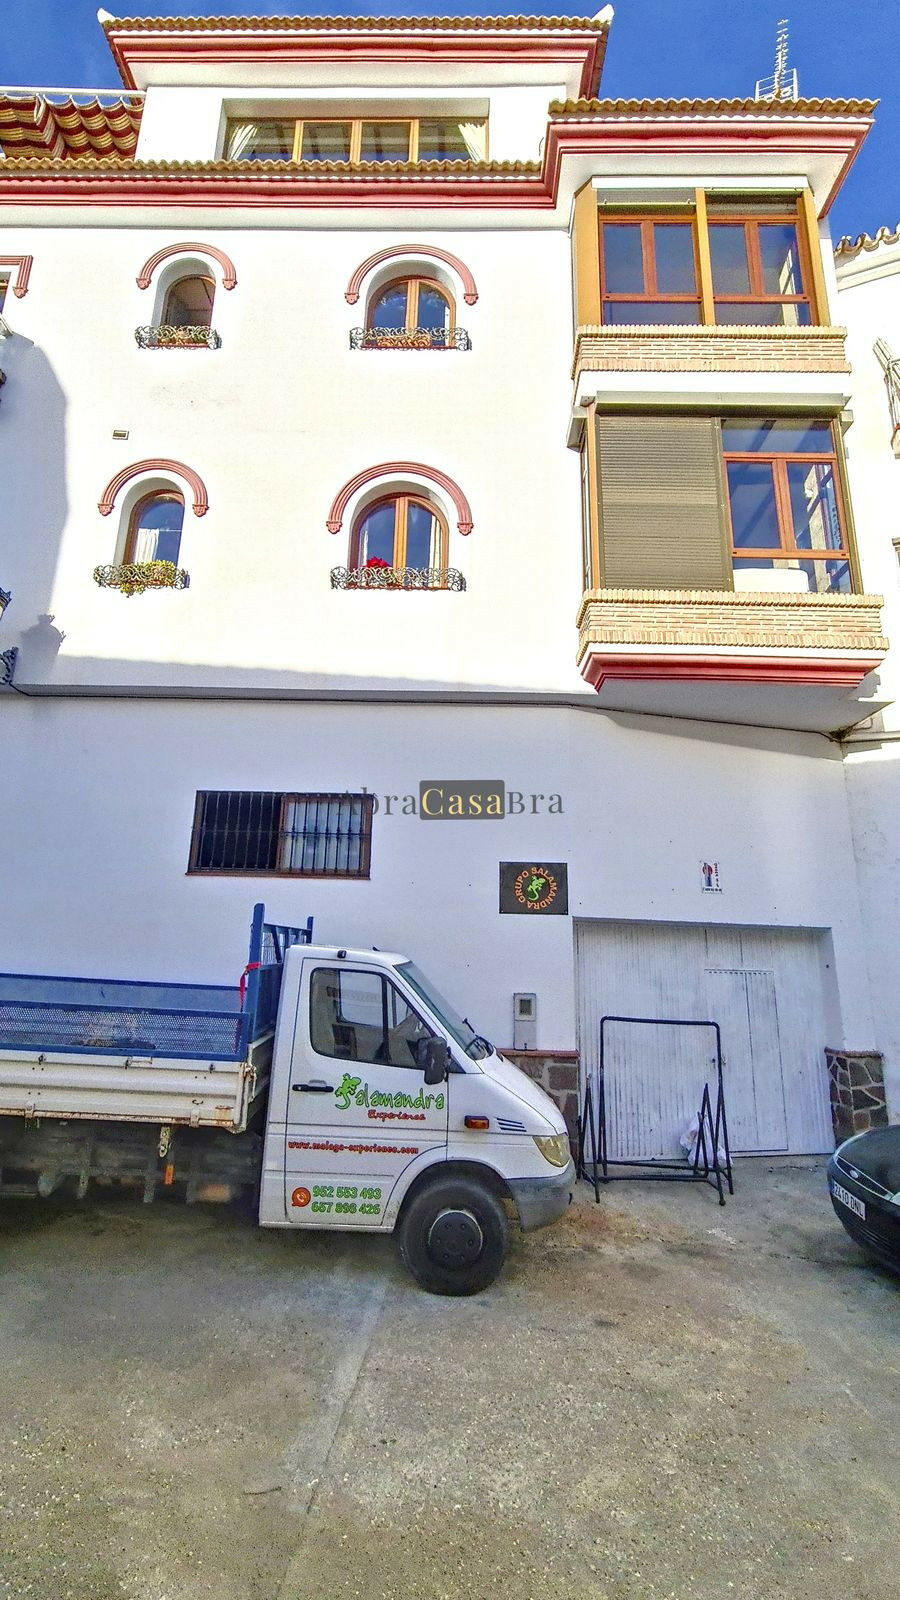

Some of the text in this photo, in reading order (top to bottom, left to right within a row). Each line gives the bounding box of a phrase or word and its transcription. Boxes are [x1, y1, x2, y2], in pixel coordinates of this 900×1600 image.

[515, 867, 557, 909] GRUPO SALAMANDRA
[367, 1109, 426, 1122] Experience
[312, 1185, 334, 1198] 952
